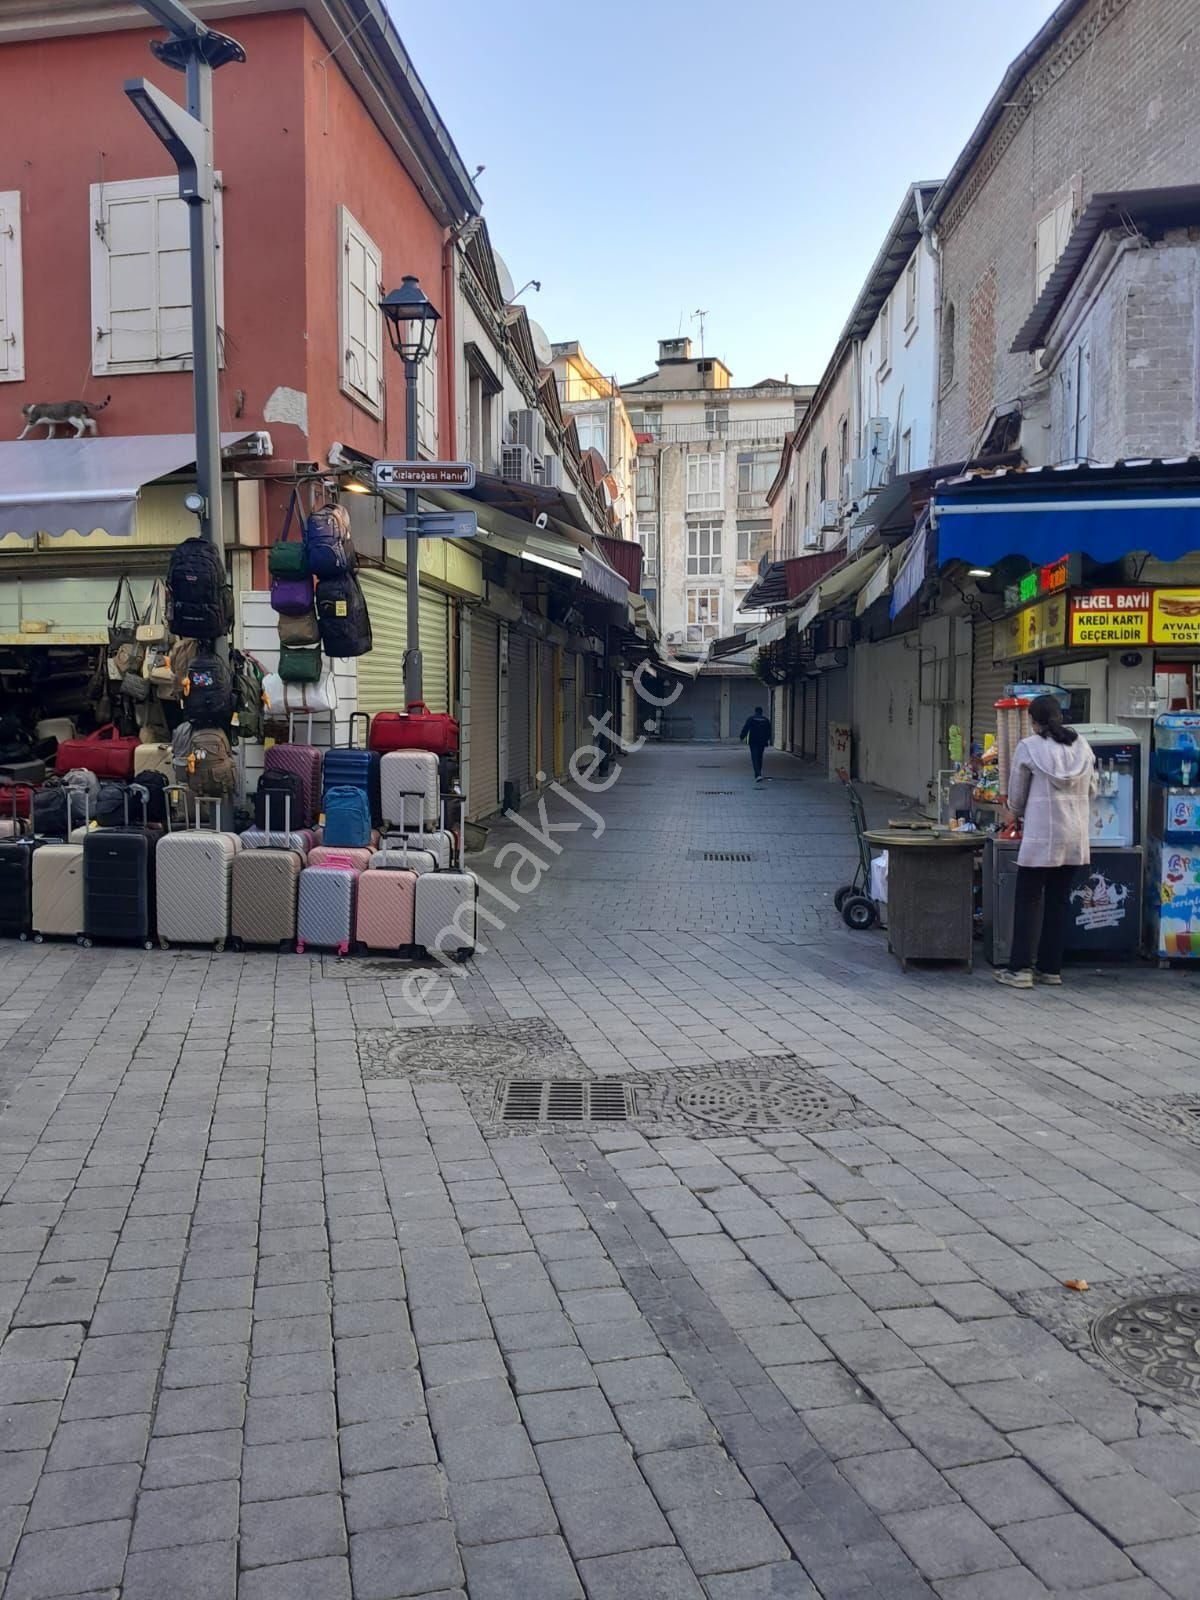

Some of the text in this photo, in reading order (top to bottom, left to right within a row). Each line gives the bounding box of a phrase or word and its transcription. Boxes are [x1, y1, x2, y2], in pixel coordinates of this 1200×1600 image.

[392, 470, 437, 482] Kızlarağası
[1073, 595, 1113, 609] TEKEL
[1078, 614, 1143, 625] KREDİ KARTI
[1080, 628, 1141, 642] GEÇERLİDİR
[1171, 632, 1200, 640] TOST
